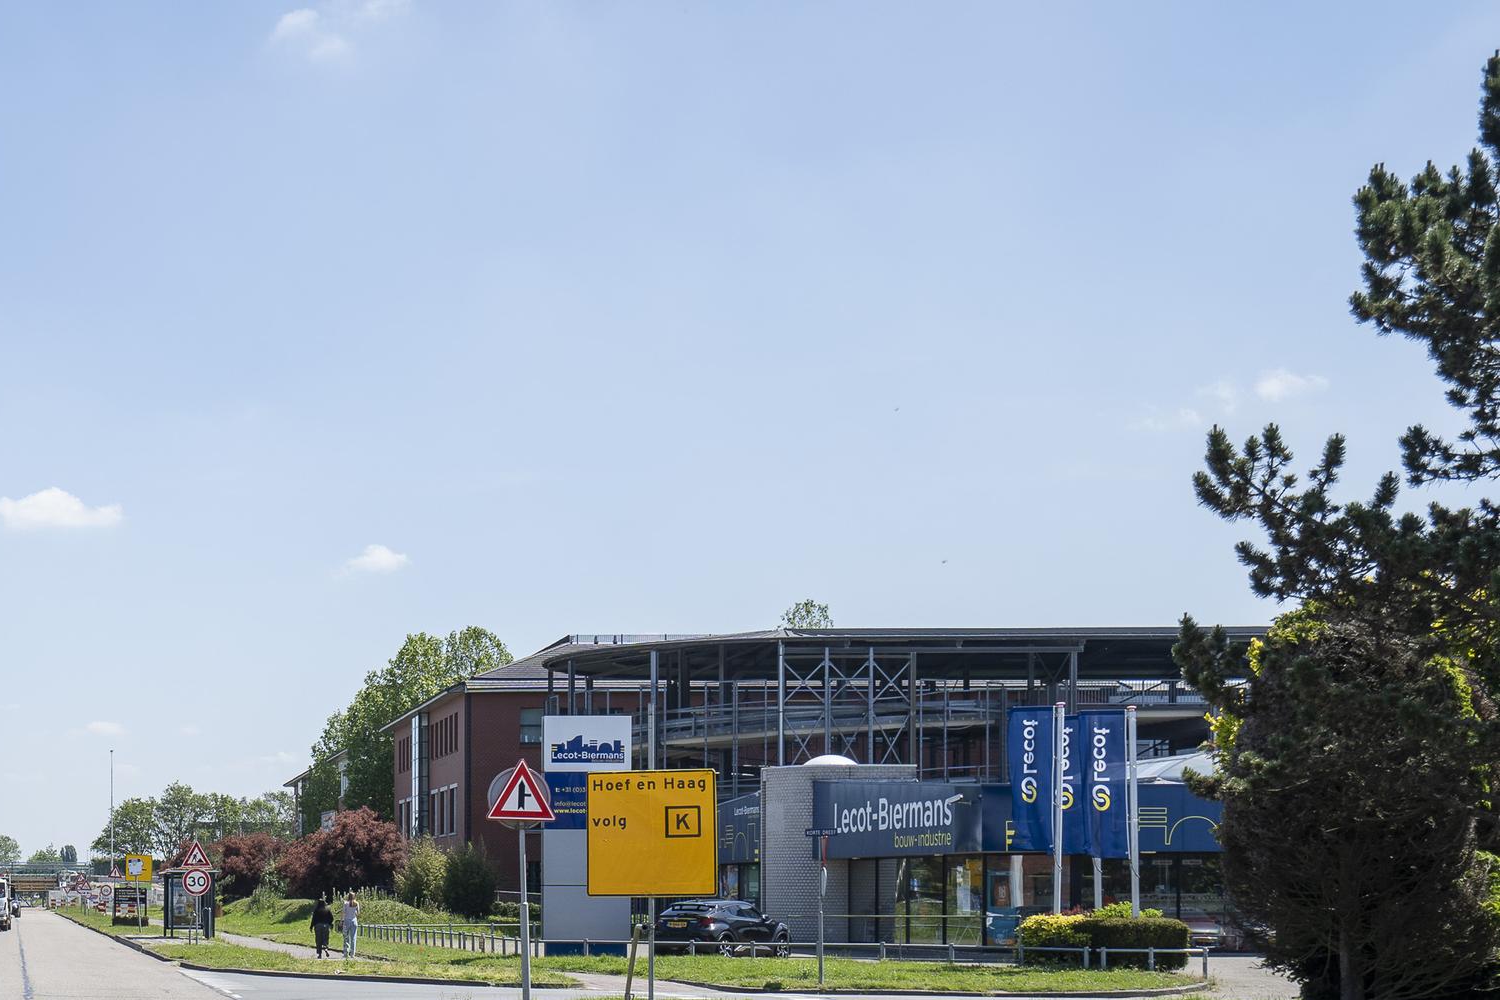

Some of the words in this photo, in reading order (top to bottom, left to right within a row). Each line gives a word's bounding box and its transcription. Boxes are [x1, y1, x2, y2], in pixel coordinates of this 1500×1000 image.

[552, 751, 624, 759] Lecot-Biermans
[592, 778, 631, 792] Hoef
[636, 780, 656, 790] en
[664, 777, 706, 792] Haag
[592, 815, 627, 830] volg
[675, 813, 690, 830] K
[833, 797, 953, 834] Lecot-Biermans
[894, 832, 952, 848] bouw-industrie
[187, 876, 206, 887] 30
